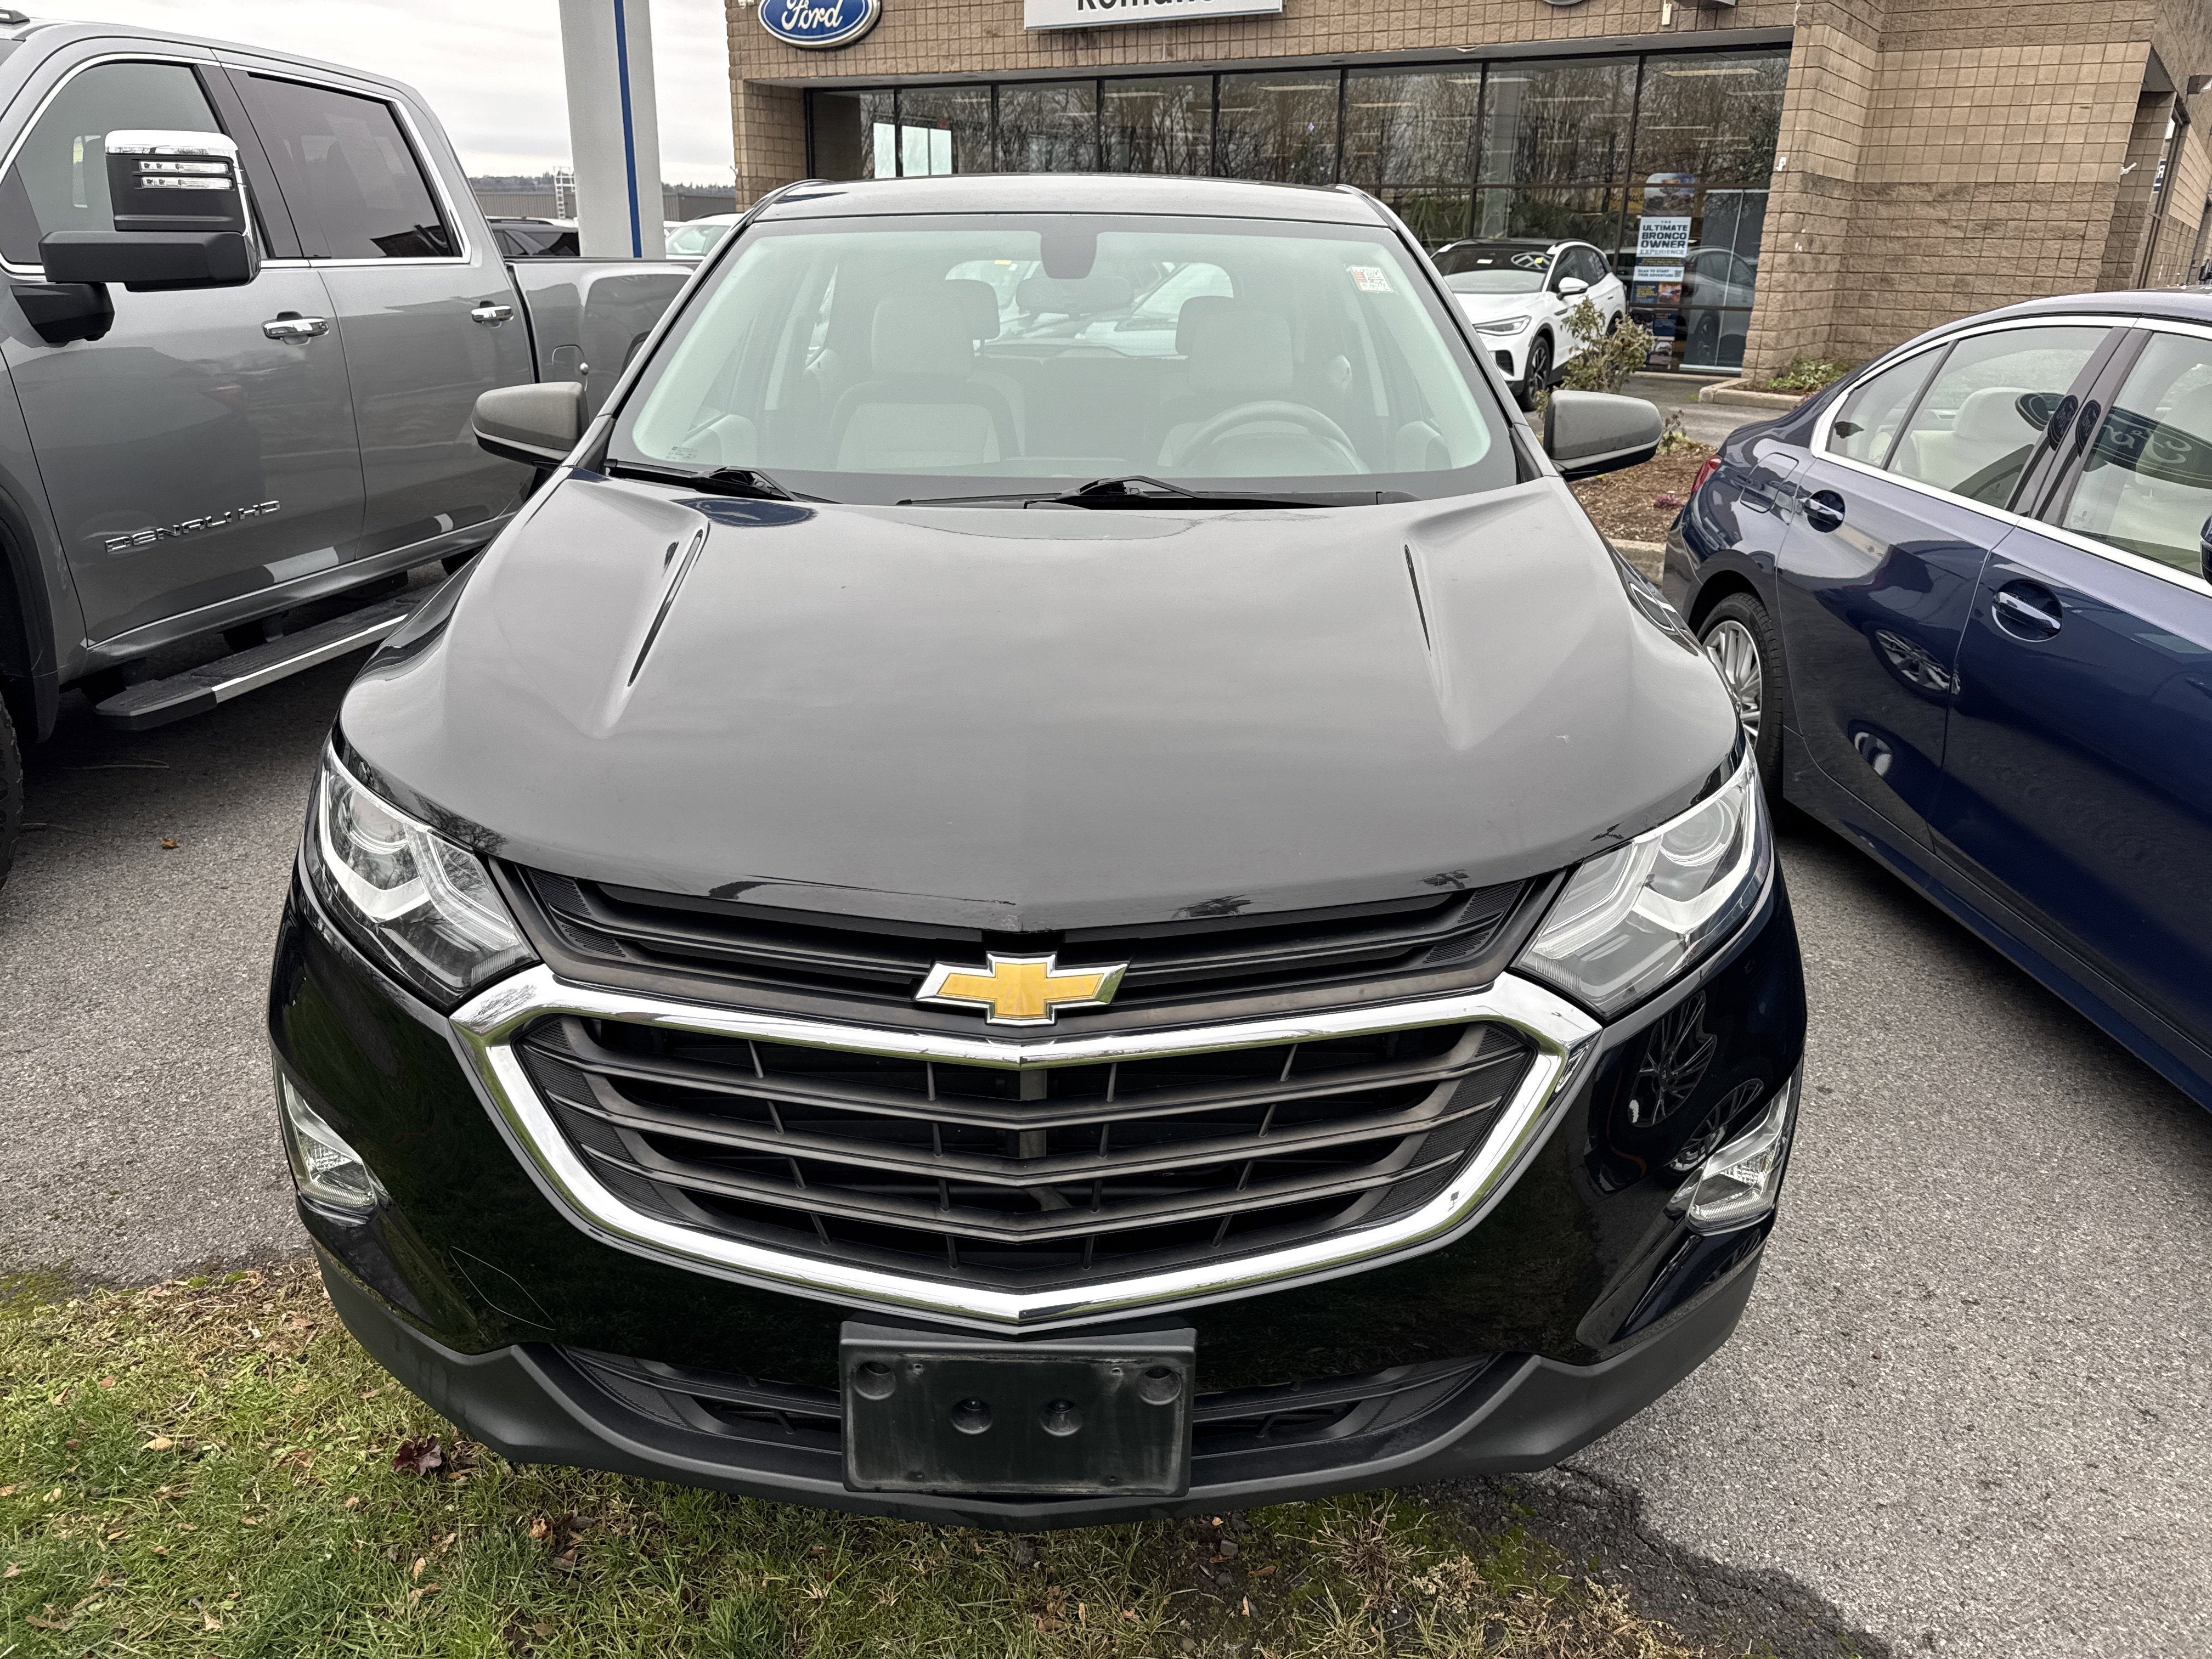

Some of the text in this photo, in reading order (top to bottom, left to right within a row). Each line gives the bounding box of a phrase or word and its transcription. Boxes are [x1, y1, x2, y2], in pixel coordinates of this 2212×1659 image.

[781, 0, 843, 30] Ford
[1641, 240, 1686, 248] OWNER
[105, 500, 280, 553] DENALI HD
